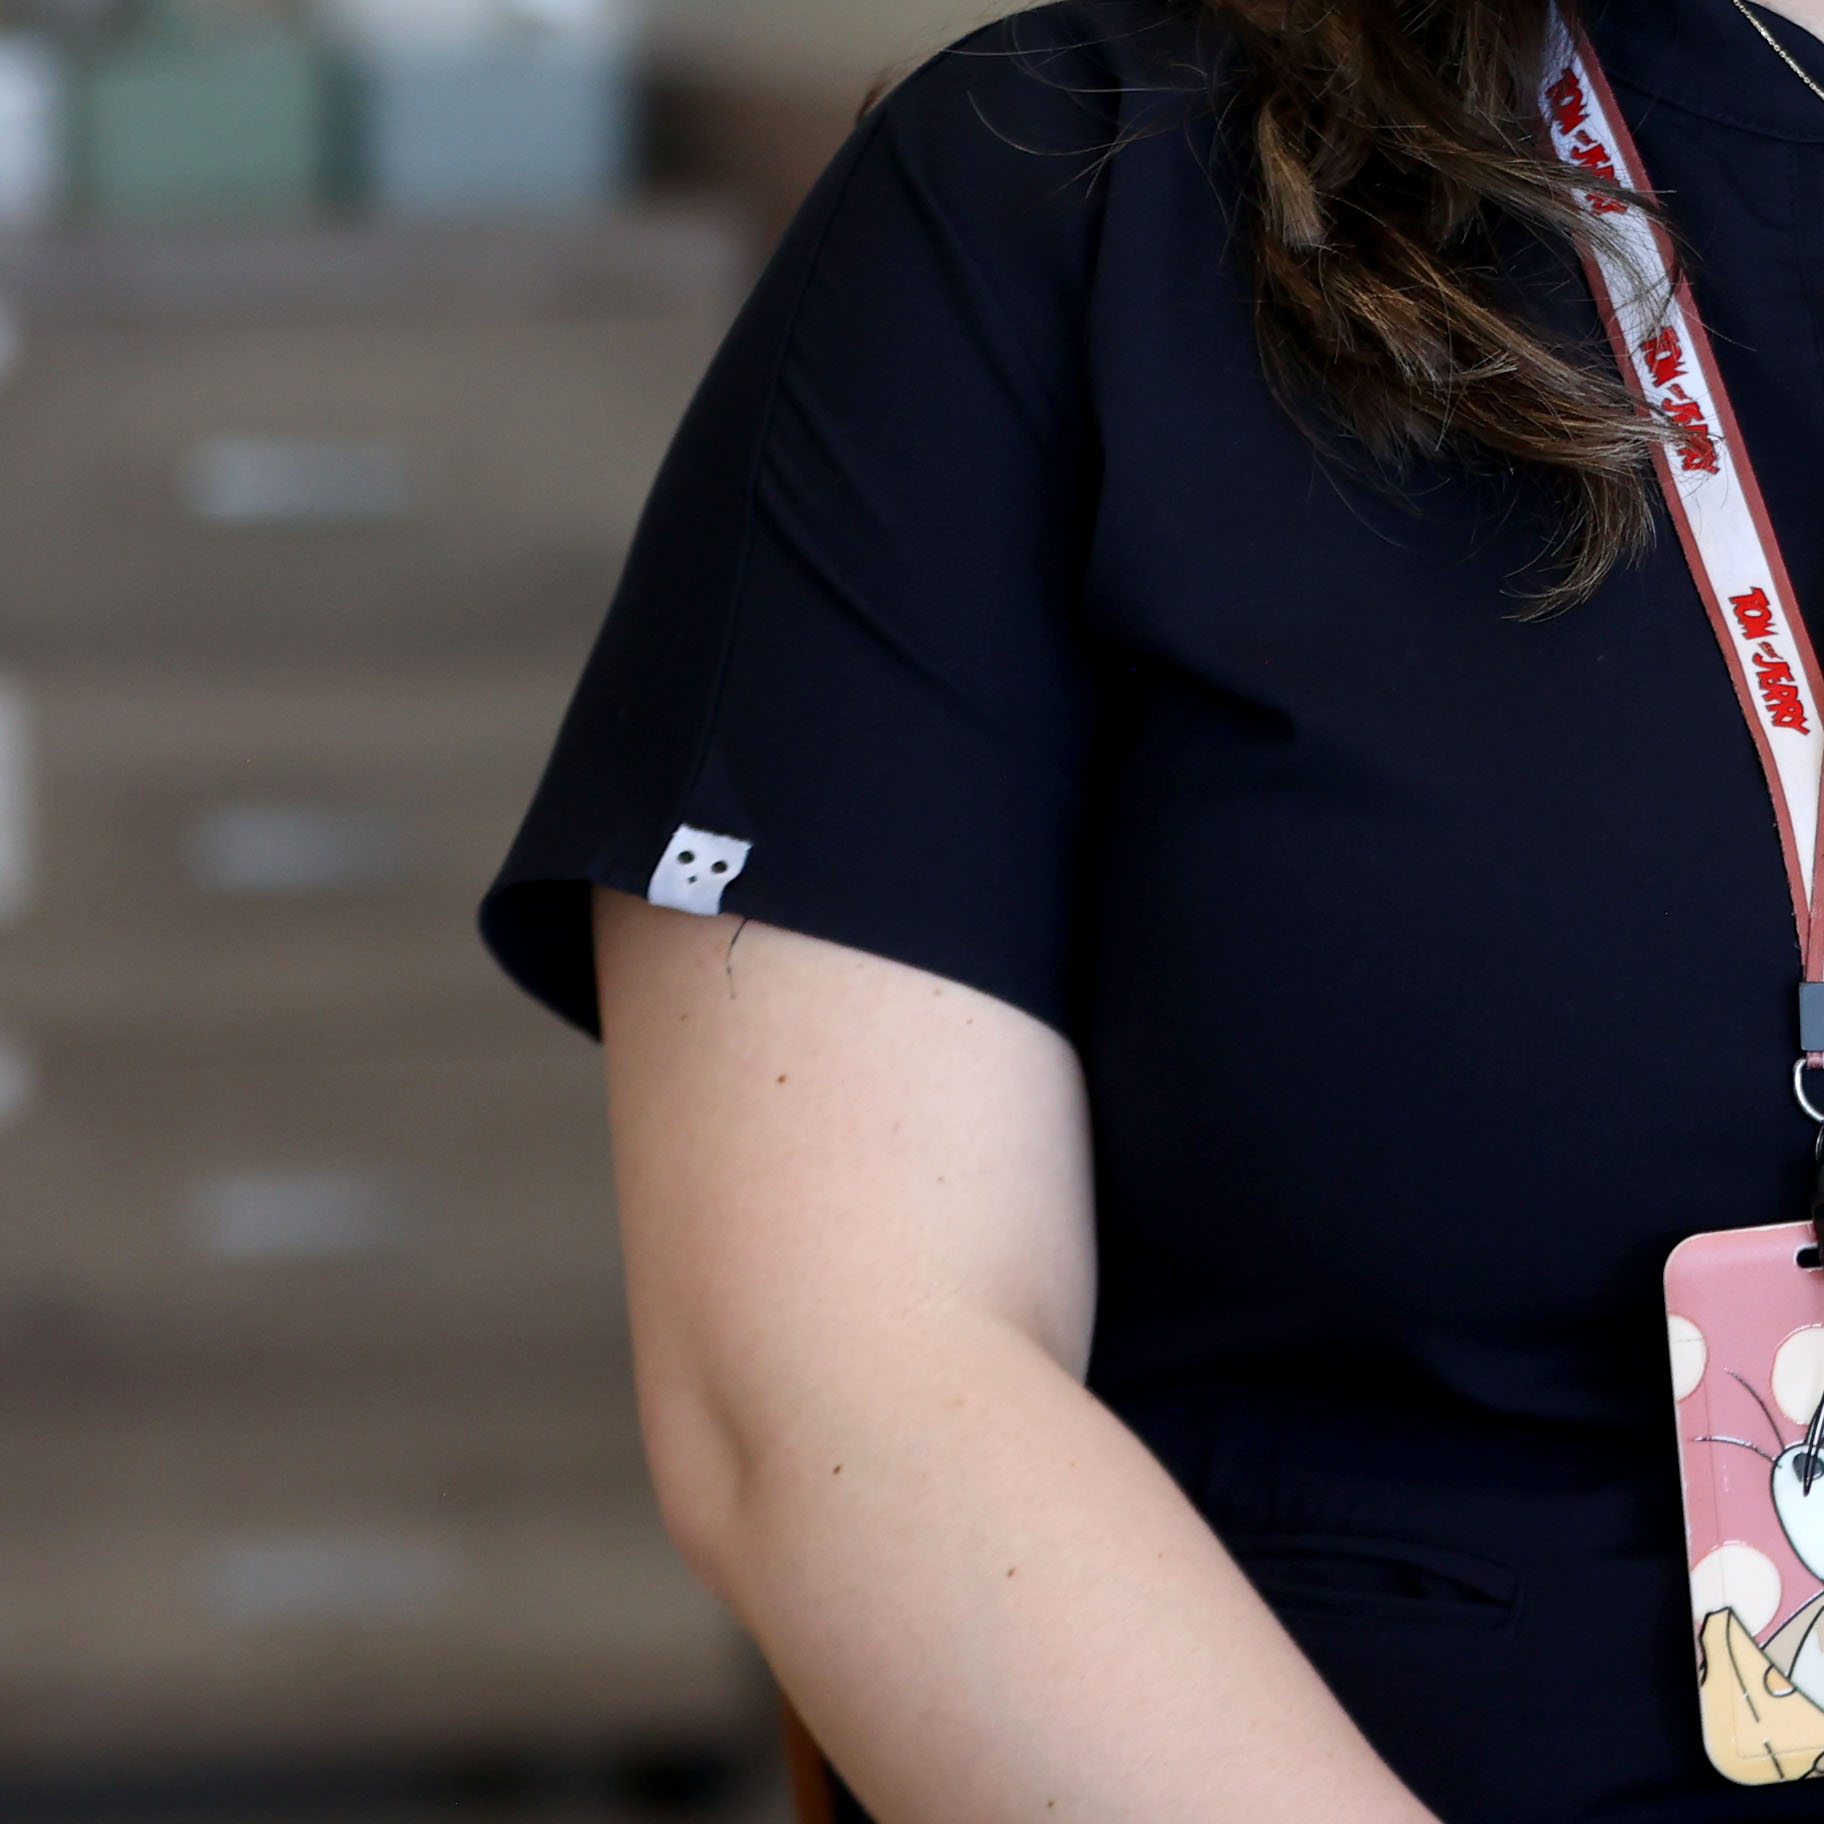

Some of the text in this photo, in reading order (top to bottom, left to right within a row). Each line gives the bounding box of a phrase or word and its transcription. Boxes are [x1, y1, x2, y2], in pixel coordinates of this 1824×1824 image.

[1571, 144, 1628, 215] JEY
[1641, 327, 1689, 387] TOM
[1728, 586, 1780, 640] TOM
[1752, 652, 1811, 736] JERRY
